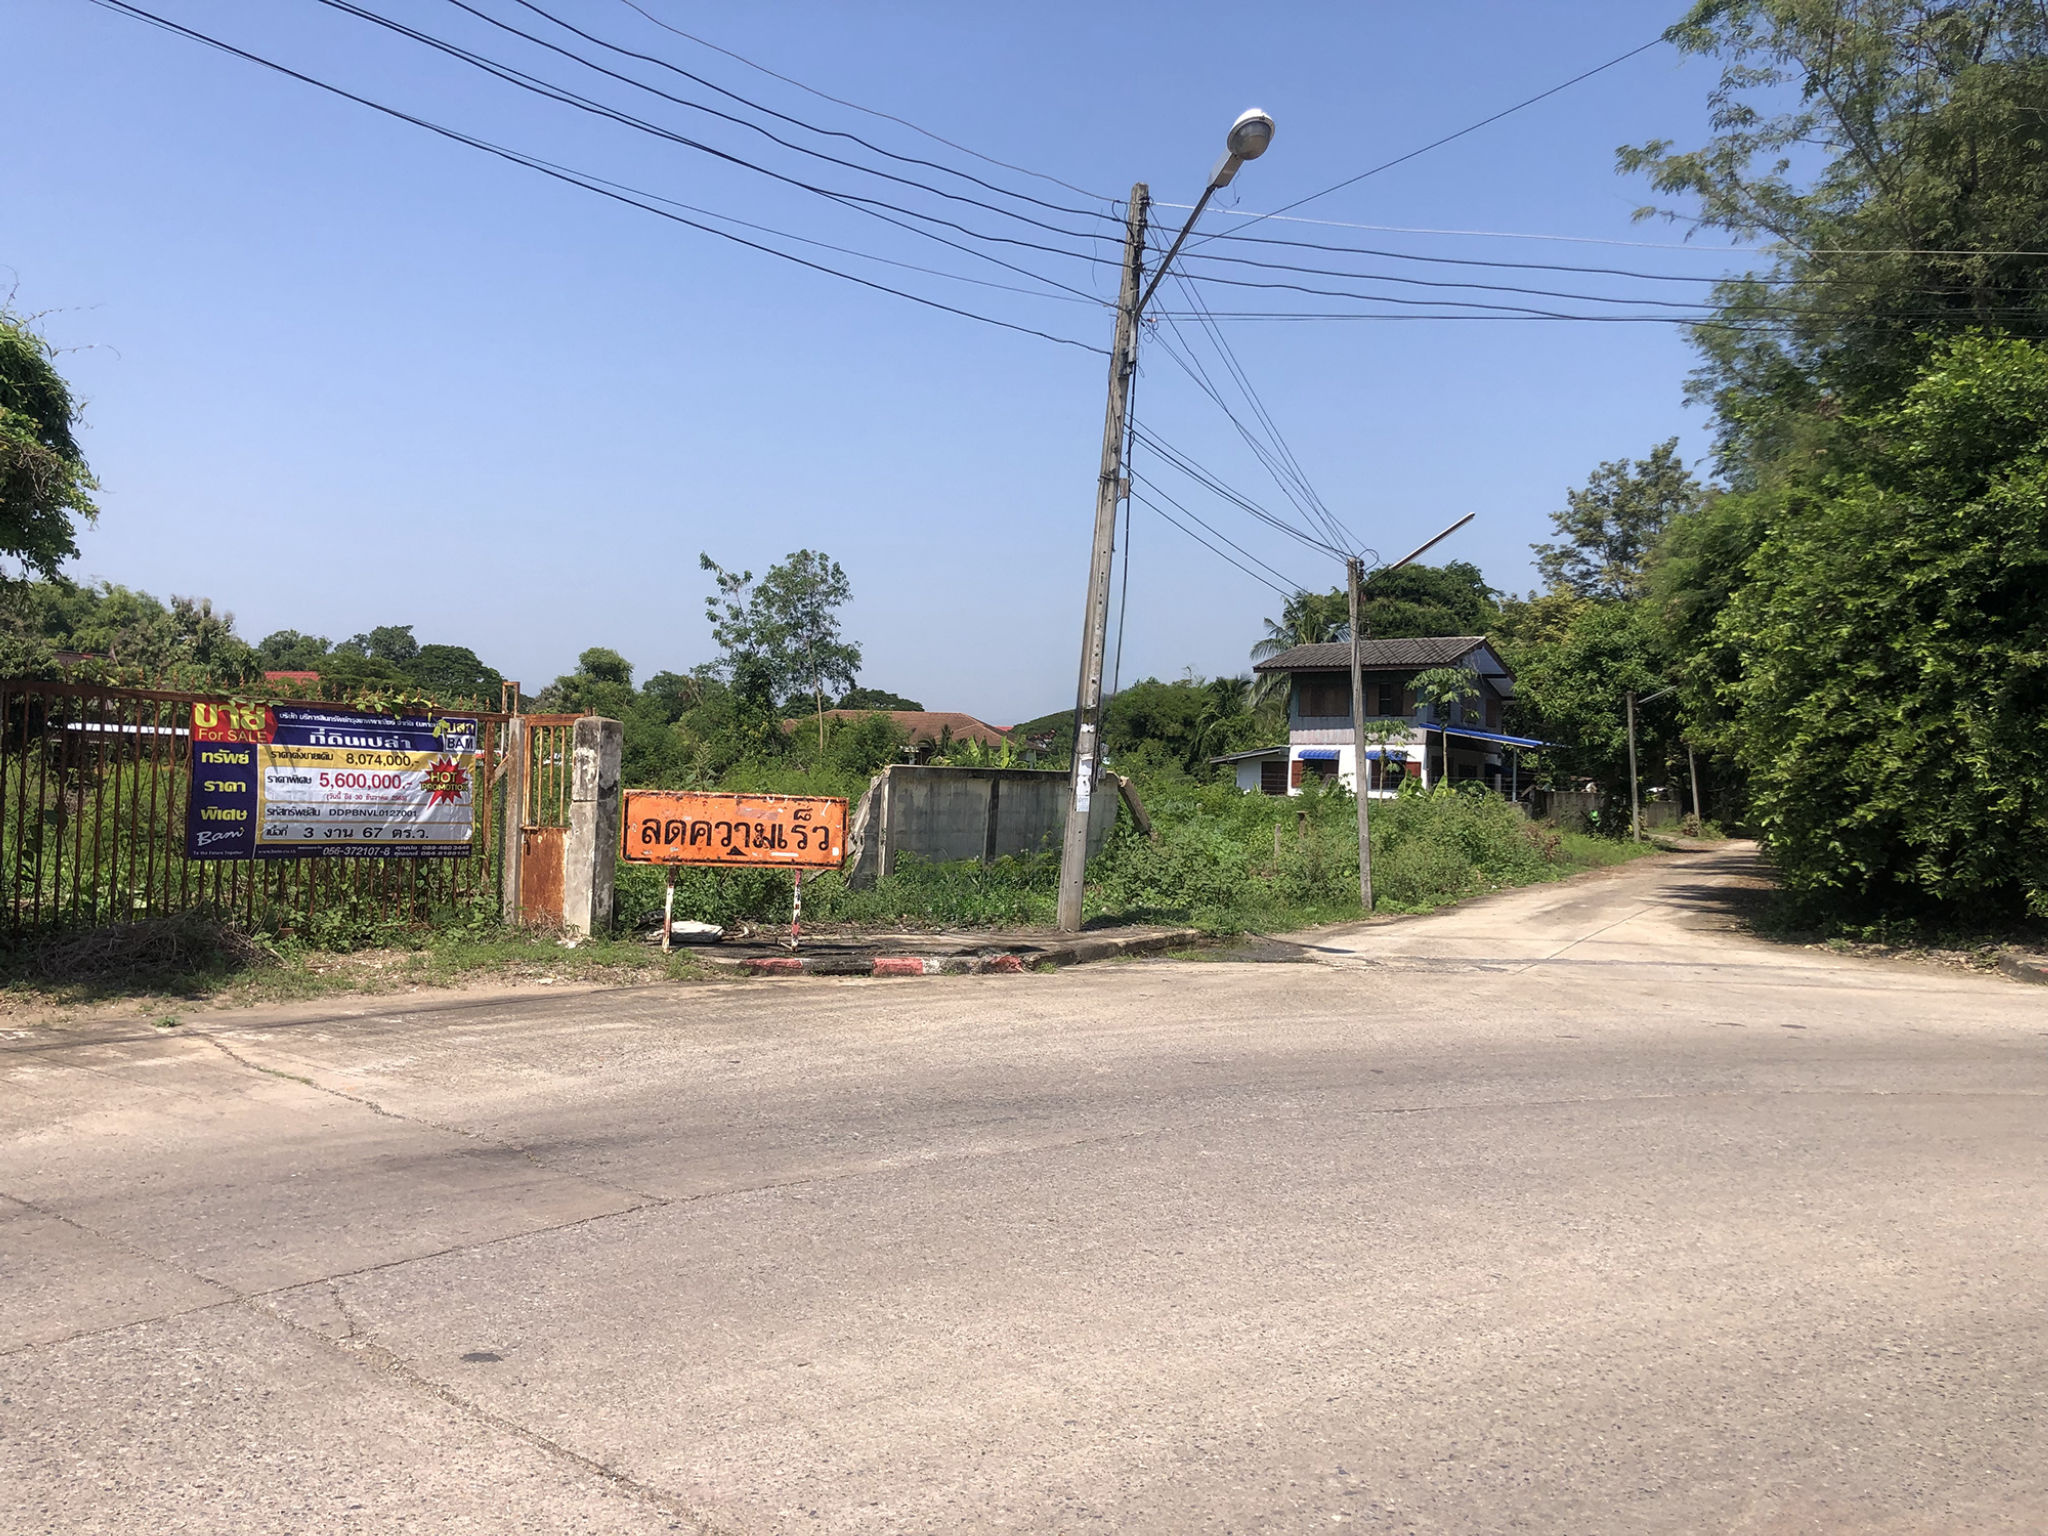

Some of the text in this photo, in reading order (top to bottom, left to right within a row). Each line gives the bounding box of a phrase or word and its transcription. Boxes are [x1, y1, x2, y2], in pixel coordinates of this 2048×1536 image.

[199, 727, 267, 744] For SALE
[309, 728, 412, 749] ที่ดินเปล่า
[447, 736, 474, 751] BAM
[201, 748, 251, 765] ทรัพย์
[430, 771, 457, 783] HOT
[203, 780, 246, 793] ราคา
[201, 806, 248, 821] พิเศษ
[303, 827, 314, 838] 3
[324, 828, 354, 839] งาน
[362, 827, 383, 839] 67
[641, 807, 830, 851] ลดความเร็ว
